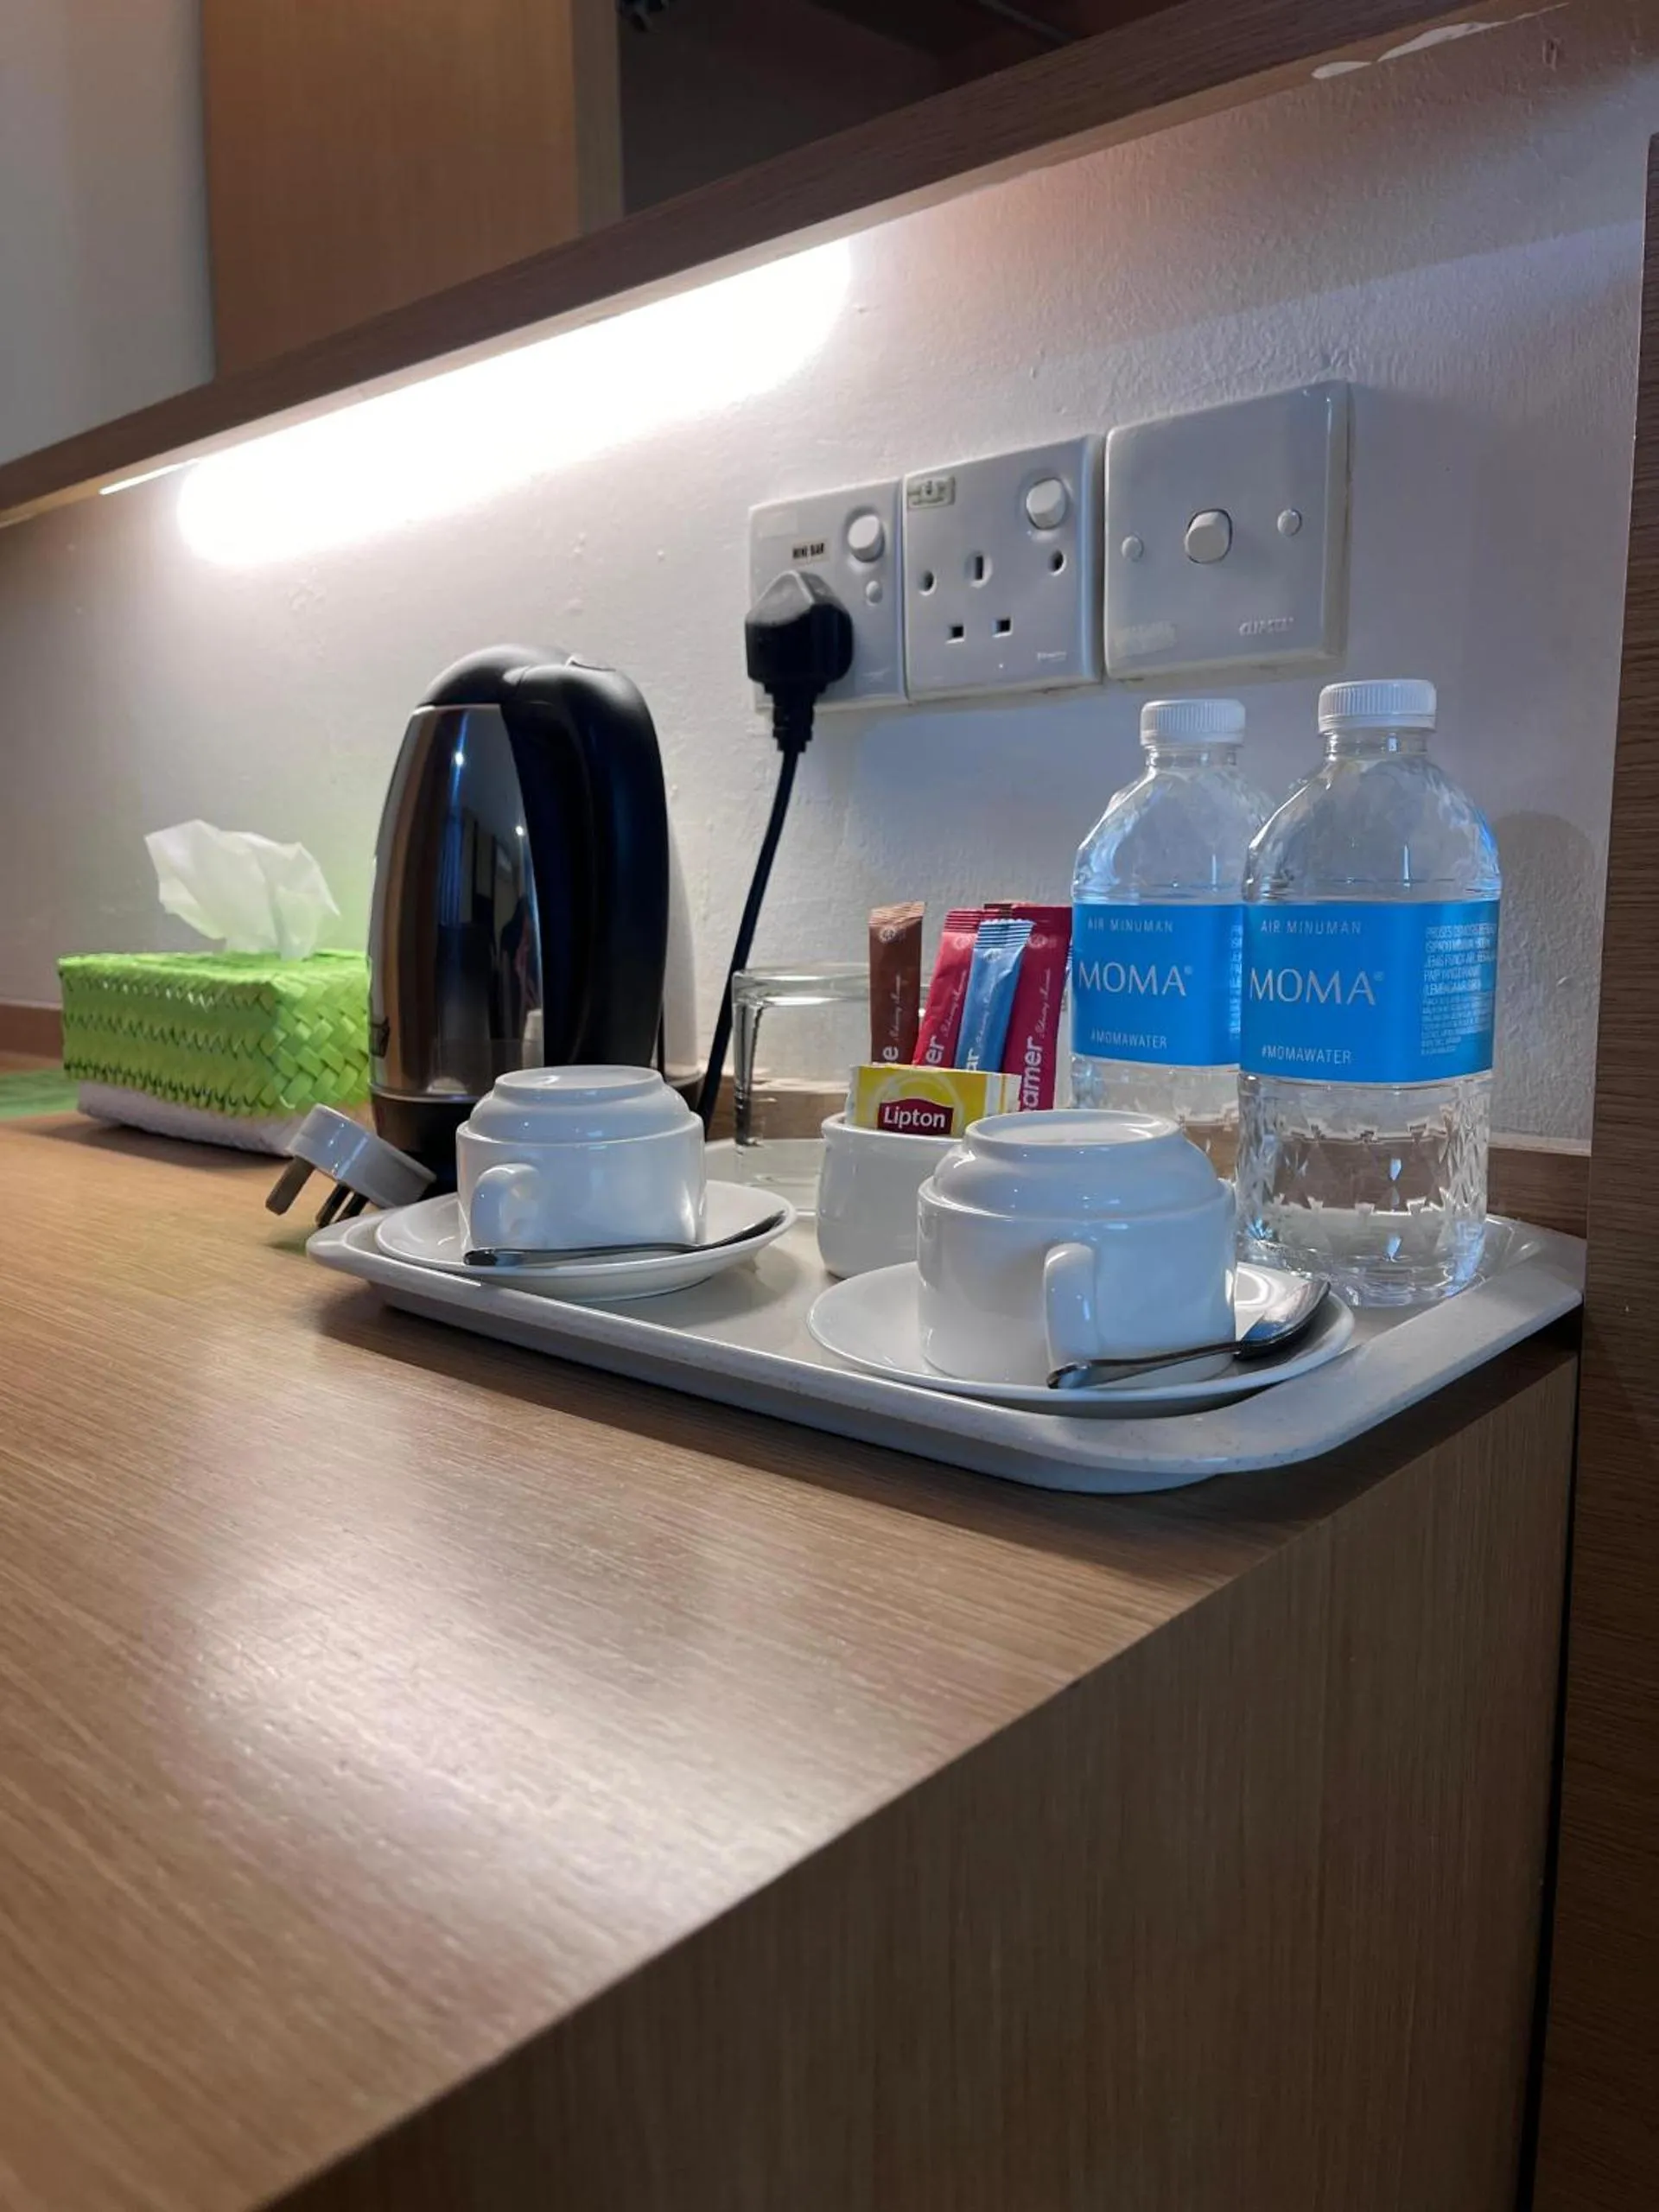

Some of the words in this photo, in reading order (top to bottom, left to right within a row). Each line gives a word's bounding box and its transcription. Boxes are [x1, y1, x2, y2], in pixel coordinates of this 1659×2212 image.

[1087, 917, 1104, 932] AIR
[1109, 918, 1173, 933] MINUMAN
[1261, 919, 1281, 934] AIR
[1287, 920, 1362, 935] MINUMAN
[1090, 1027, 1167, 1049] #MOMAWATER
[1262, 1044, 1352, 1065] #MOMAWATER
[1023, 1035, 1044, 1111] amer
[883, 1105, 946, 1128] Lipton
